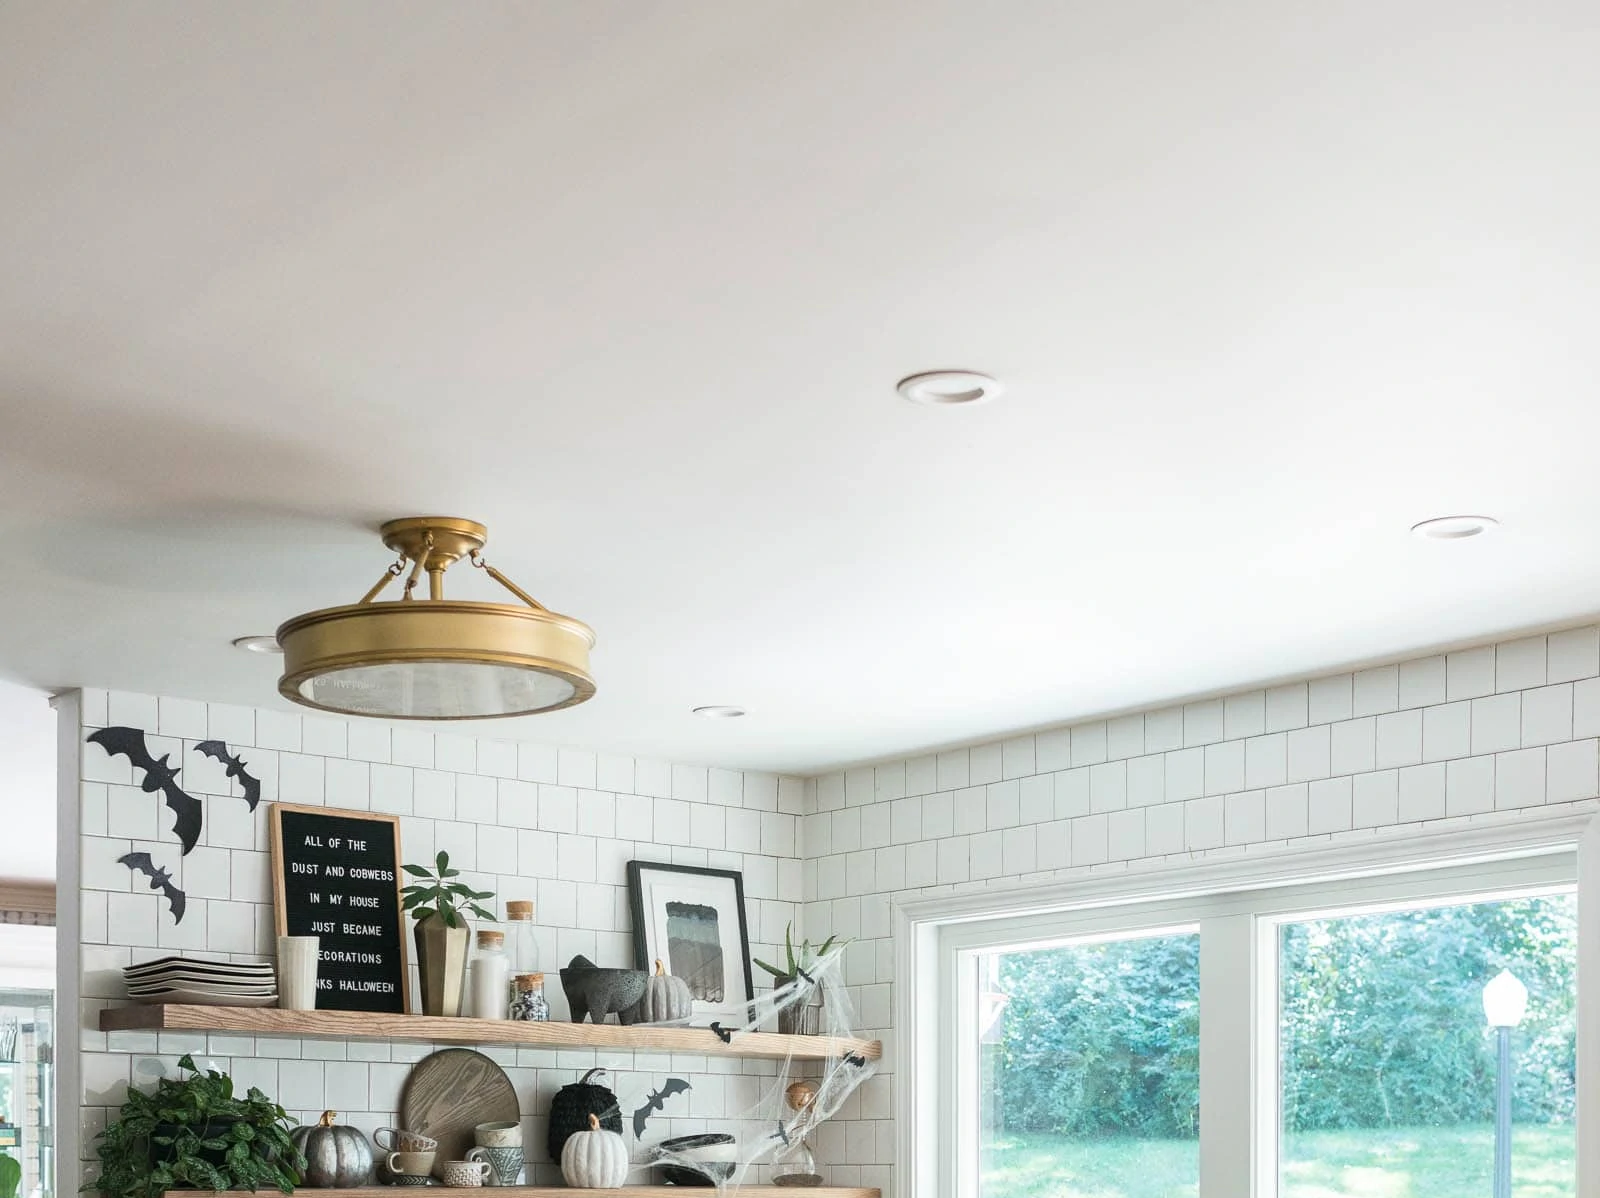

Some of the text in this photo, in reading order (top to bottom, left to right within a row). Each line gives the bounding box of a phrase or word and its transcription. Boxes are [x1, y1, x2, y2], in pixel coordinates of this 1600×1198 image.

[305, 835, 367, 852] ALL OF THE
[292, 863, 394, 882] DUST AND COBWEBS
[310, 892, 380, 908] IN MY HOUSE
[312, 921, 382, 937] JUST BECAME
[317, 950, 382, 964] ECORATIONS
[340, 980, 395, 993] HALLOWEEN
